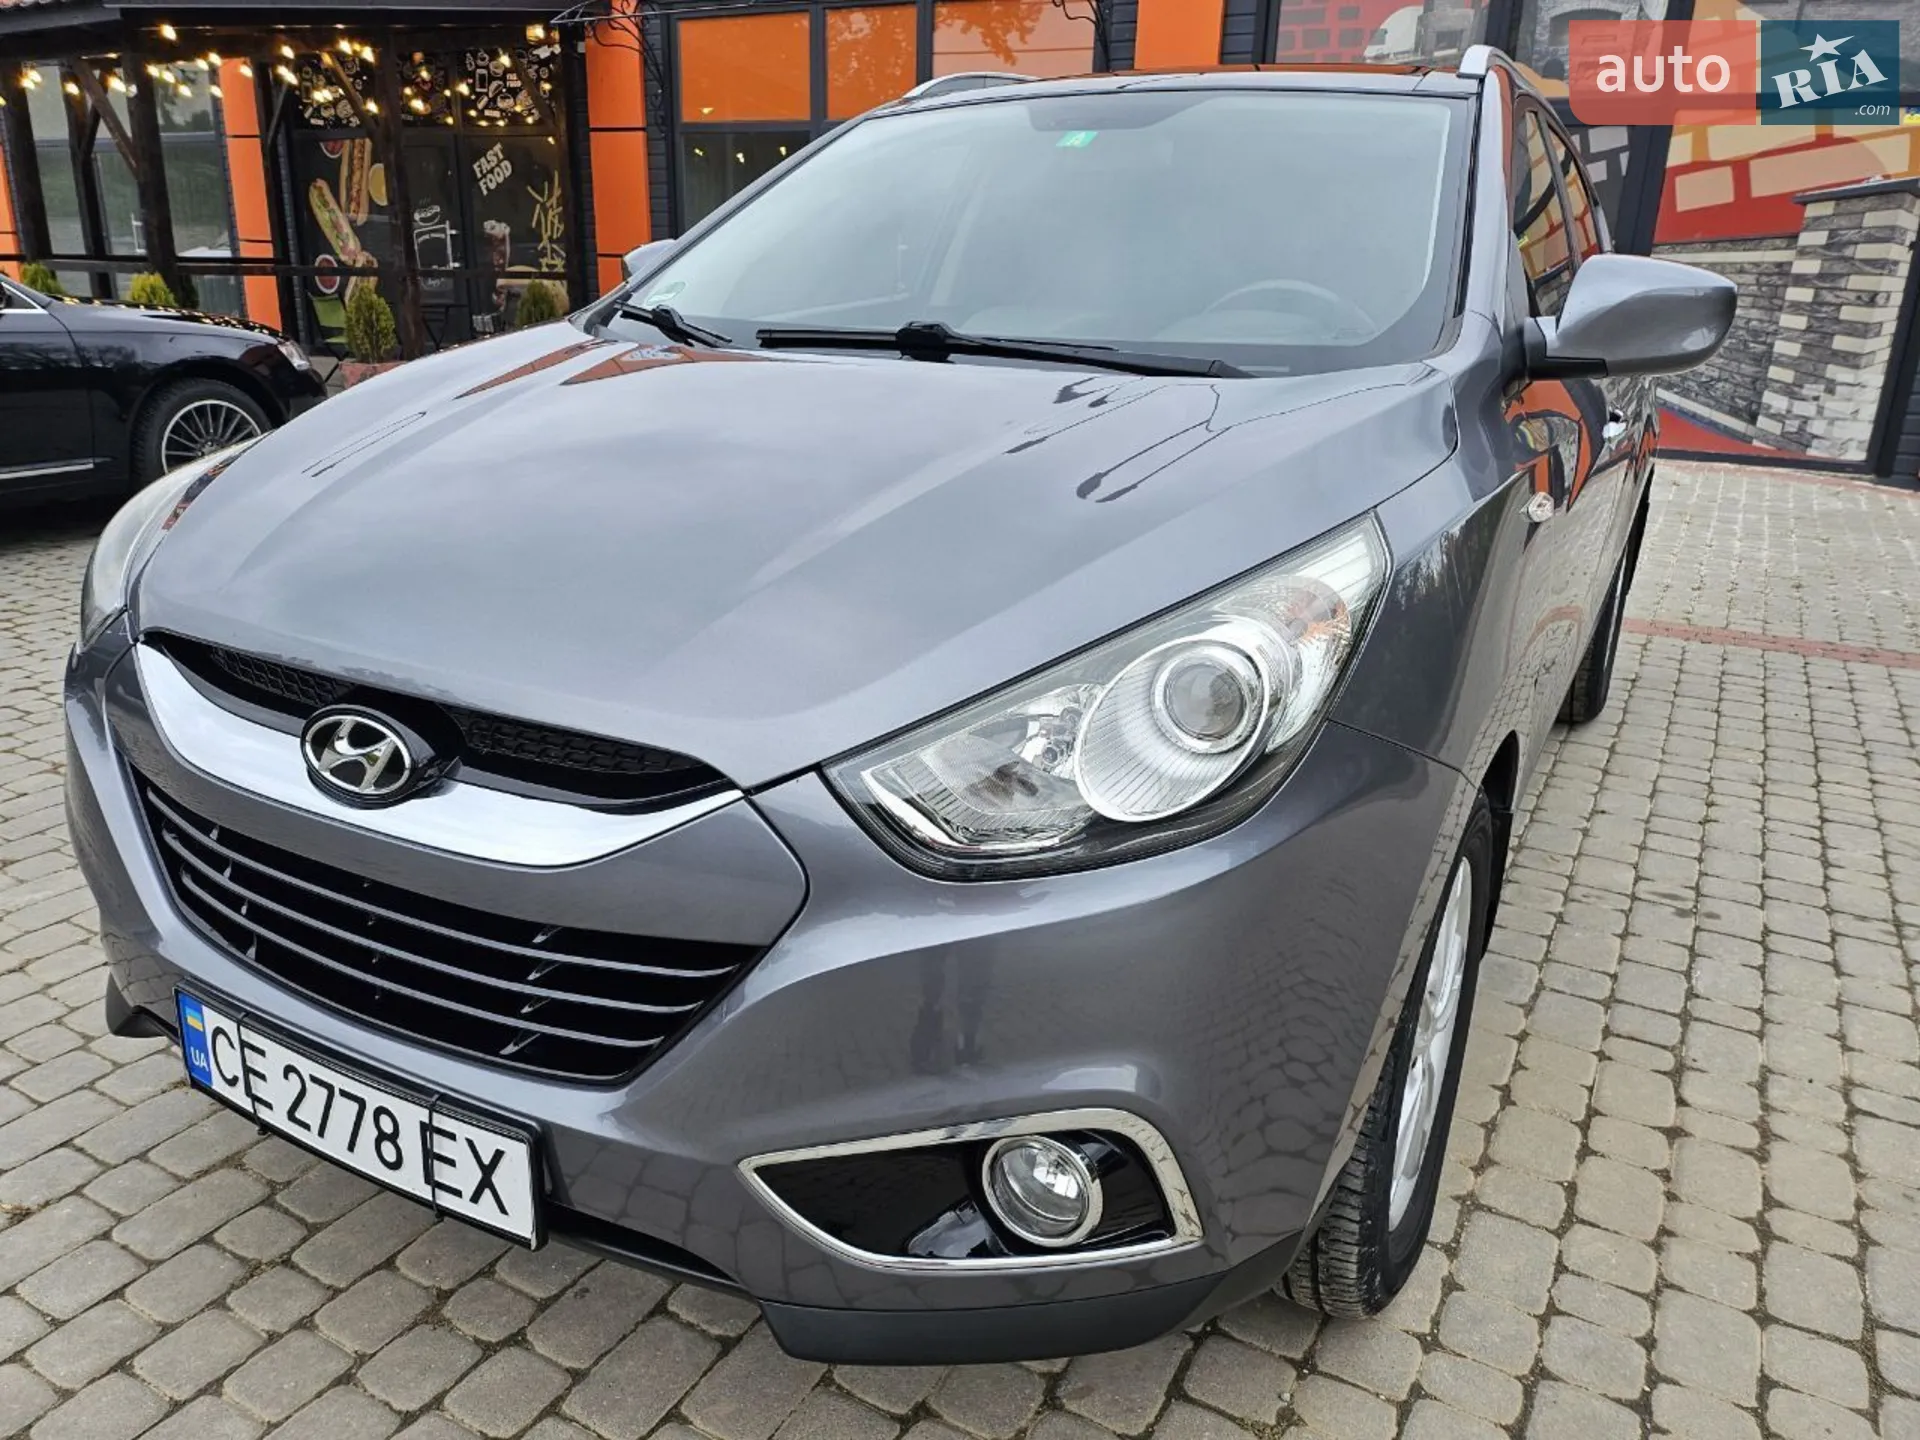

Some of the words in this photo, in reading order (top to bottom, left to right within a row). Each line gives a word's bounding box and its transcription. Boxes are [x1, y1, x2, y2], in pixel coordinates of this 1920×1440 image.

[472, 142, 504, 179] FAST
[478, 160, 513, 196] FOOD
[191, 1046, 209, 1072] UA
[211, 1026, 273, 1111] CE
[283, 1064, 404, 1171] 2778
[419, 1119, 510, 1217] EX
